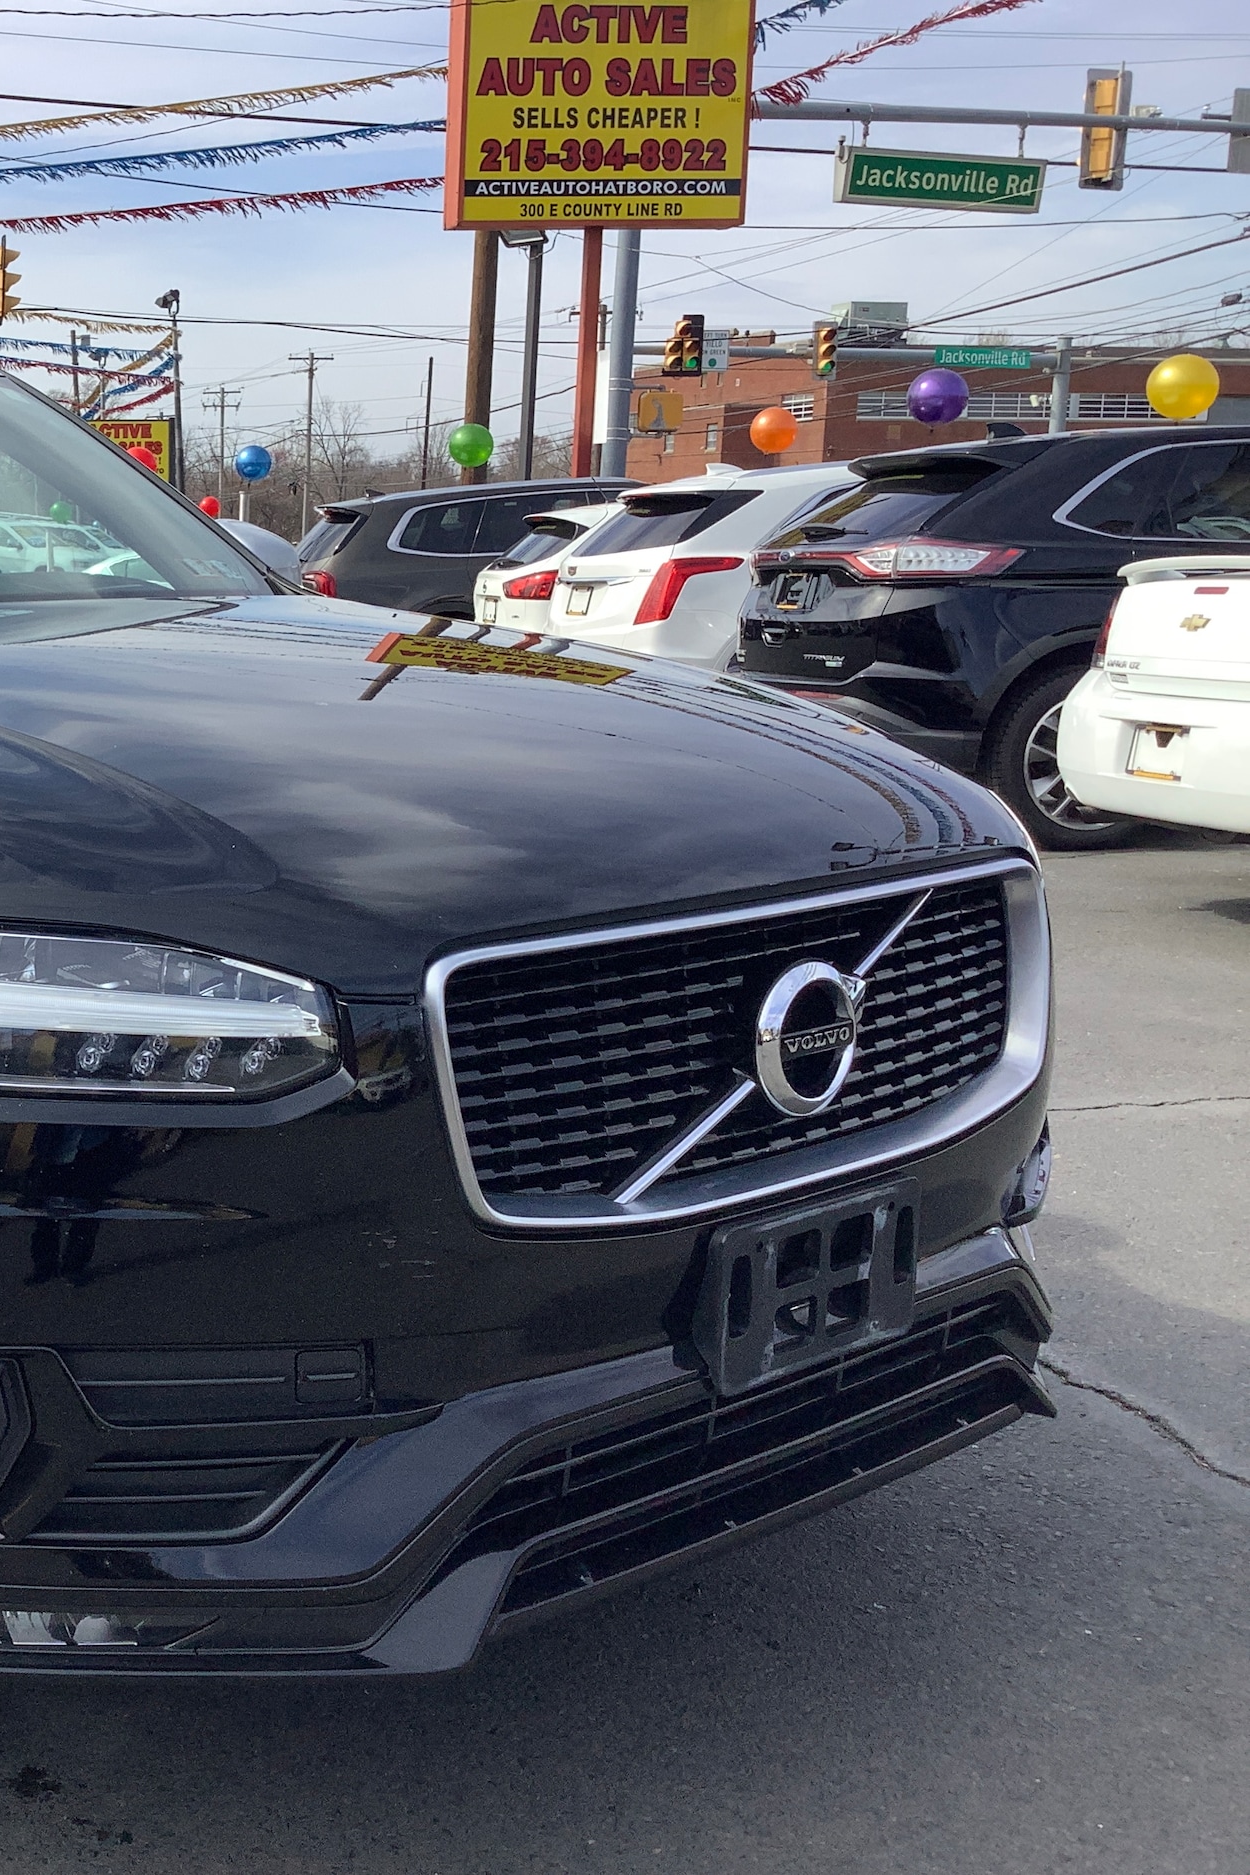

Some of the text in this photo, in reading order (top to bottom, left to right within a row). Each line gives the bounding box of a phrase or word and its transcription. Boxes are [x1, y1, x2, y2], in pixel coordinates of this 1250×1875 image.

[529, 4, 688, 44] ACTIVE
[475, 57, 737, 97] AUTO SALES
[512, 107, 579, 129] SELLS
[587, 106, 687, 129] CHEAPER
[479, 138, 727, 172] 215-394-8922
[475, 181, 727, 196] ACTIVEAUTOHATBORO.COM
[856, 164, 1034, 197] Jacksonville Rd
[519, 203, 683, 218] 300 E COUNTY LINE RD
[939, 349, 1026, 366] Jacksonville Rd
[91, 423, 153, 438] CTIVE
[784, 1026, 850, 1053] VOLVO
